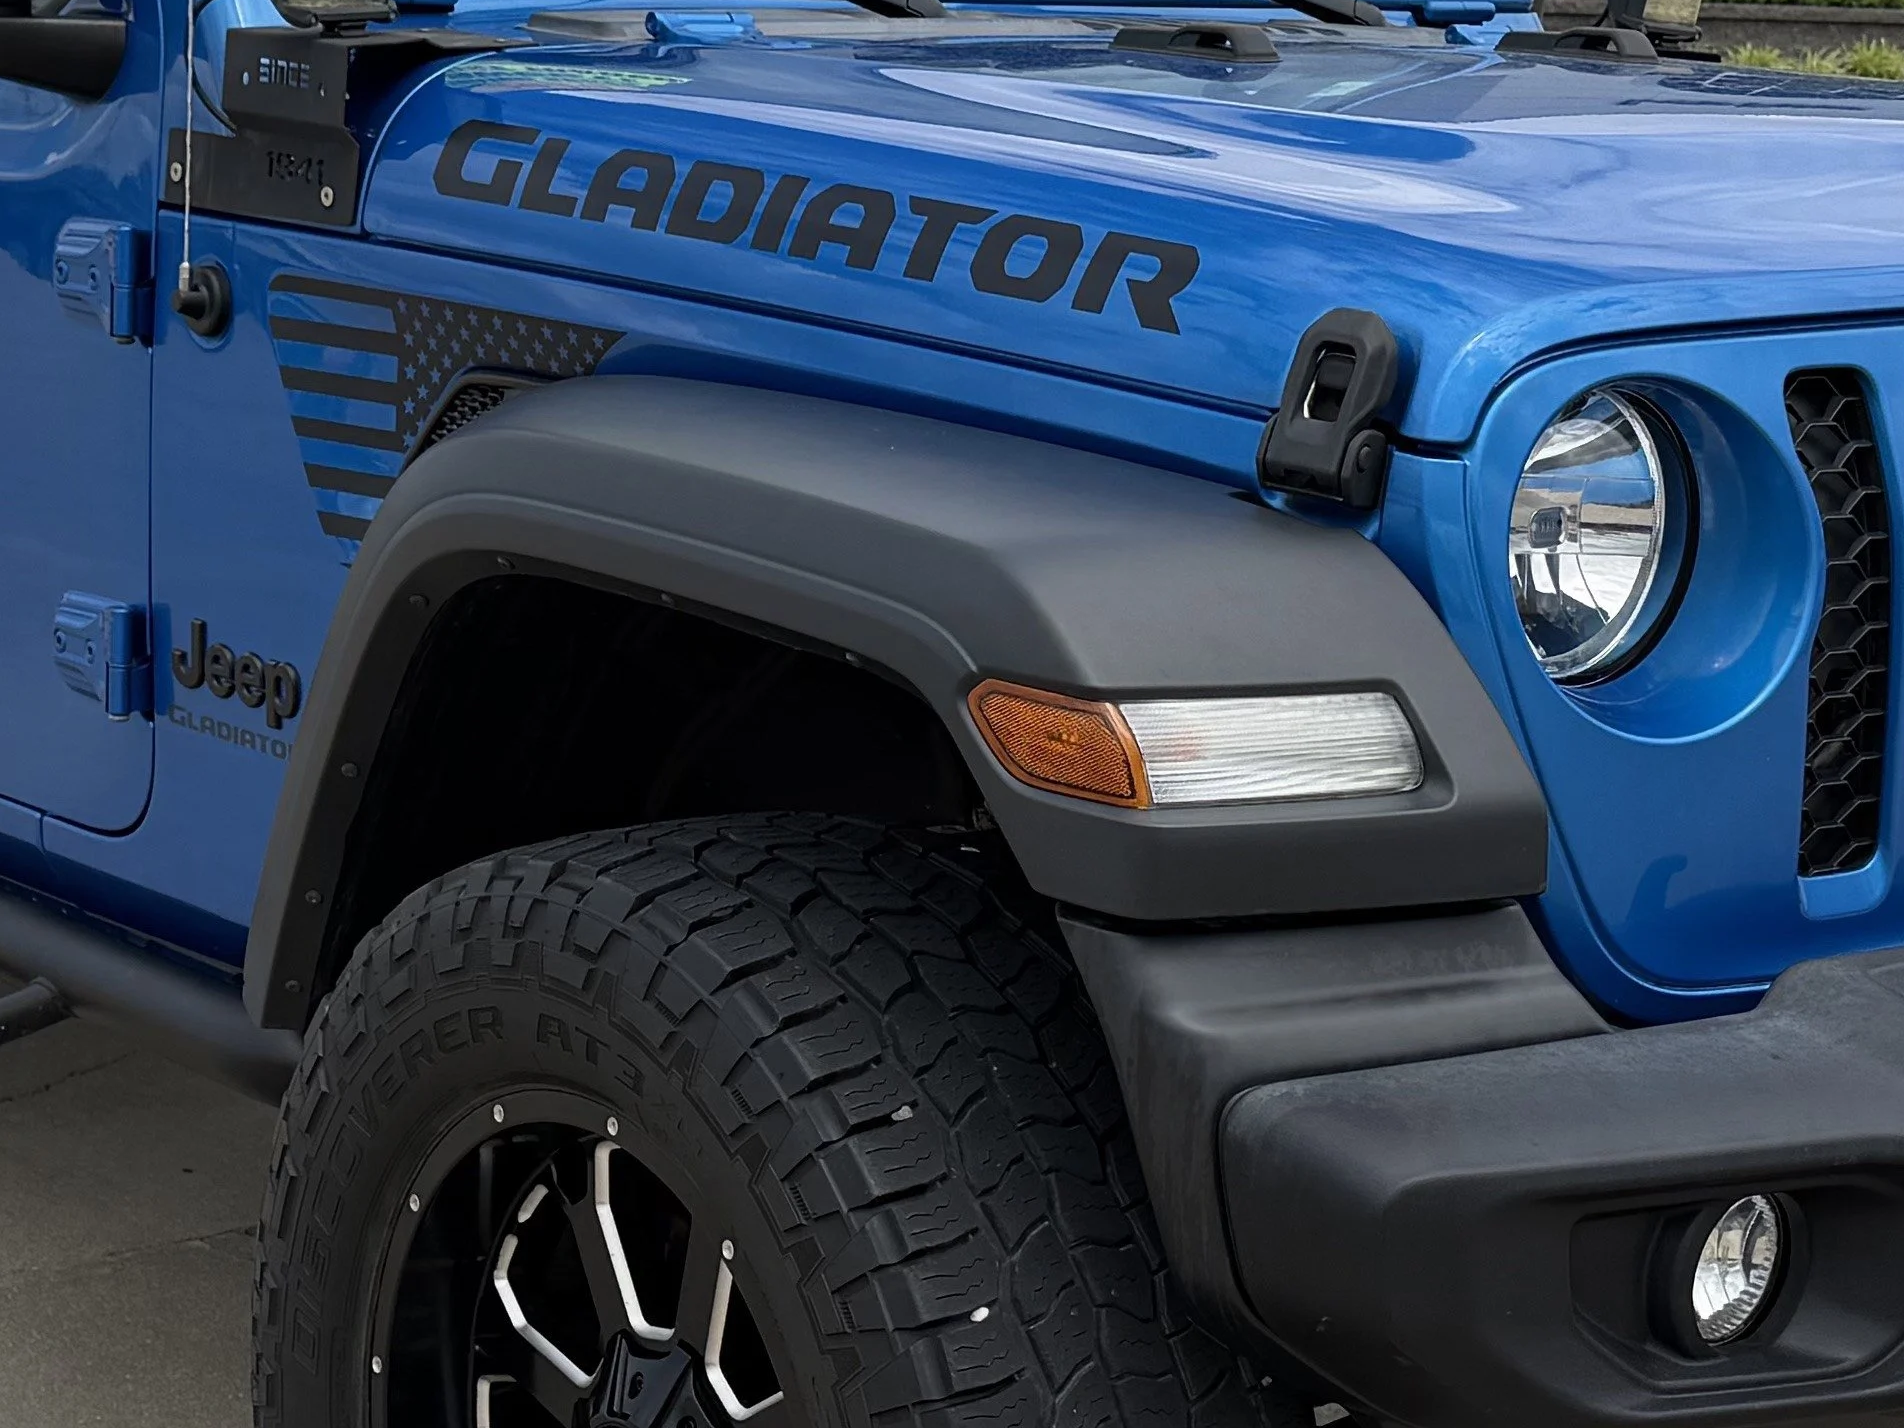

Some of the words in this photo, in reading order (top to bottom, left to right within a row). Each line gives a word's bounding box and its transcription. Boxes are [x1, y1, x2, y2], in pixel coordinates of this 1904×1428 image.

[259, 56, 312, 90] SINCE
[433, 119, 1200, 335] GLADIATOR
[172, 618, 302, 730] Jeep
